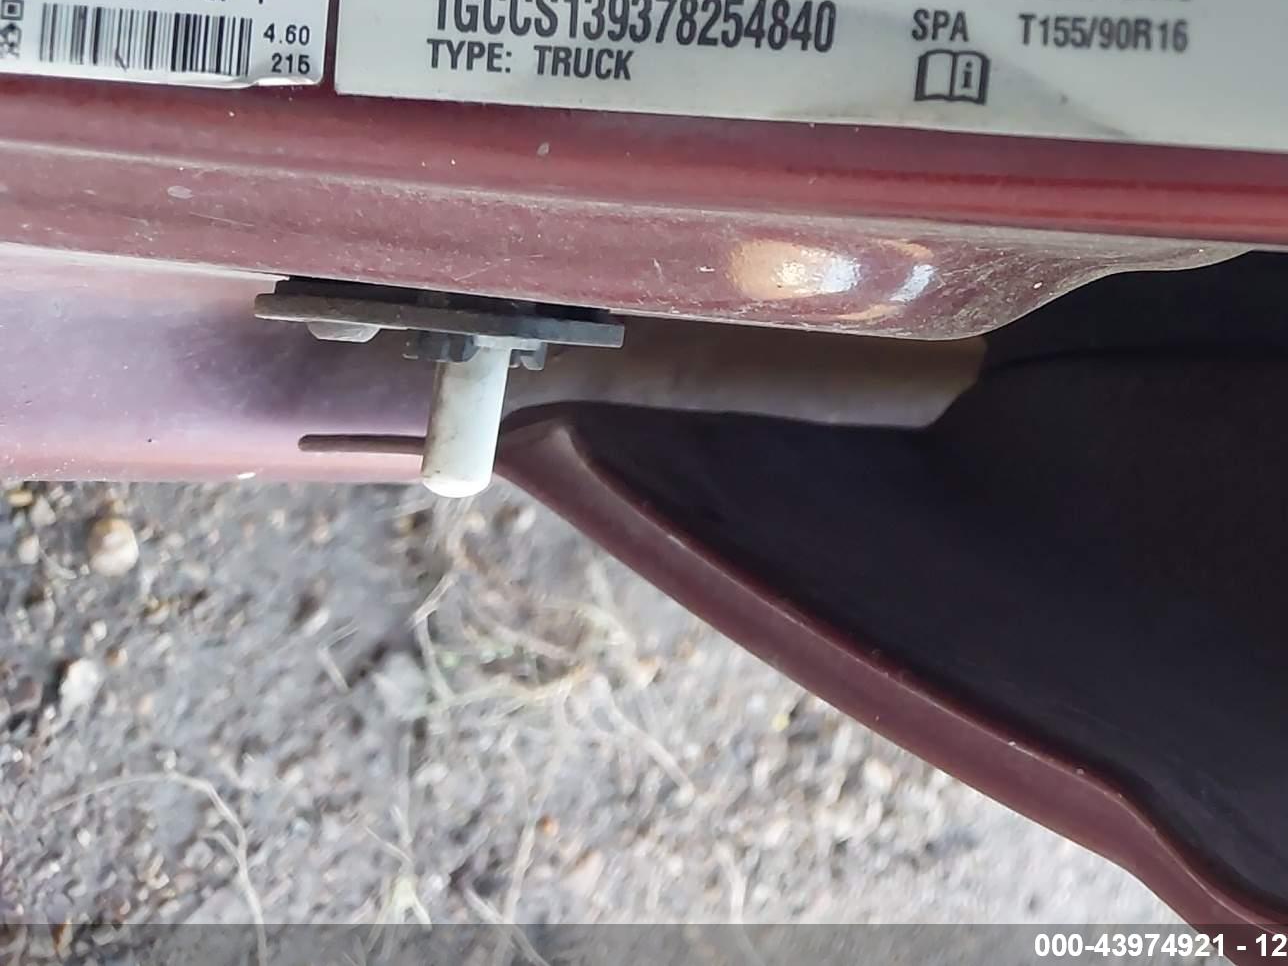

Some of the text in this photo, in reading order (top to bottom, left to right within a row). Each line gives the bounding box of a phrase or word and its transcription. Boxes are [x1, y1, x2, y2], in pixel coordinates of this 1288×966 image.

[263, 24, 310, 45] 4.60
[912, 9, 969, 43] SPA
[1019, 14, 1188, 53] T155/90R16
[271, 54, 310, 74] 215
[427, 39, 633, 80] TYPE: TRUCK
